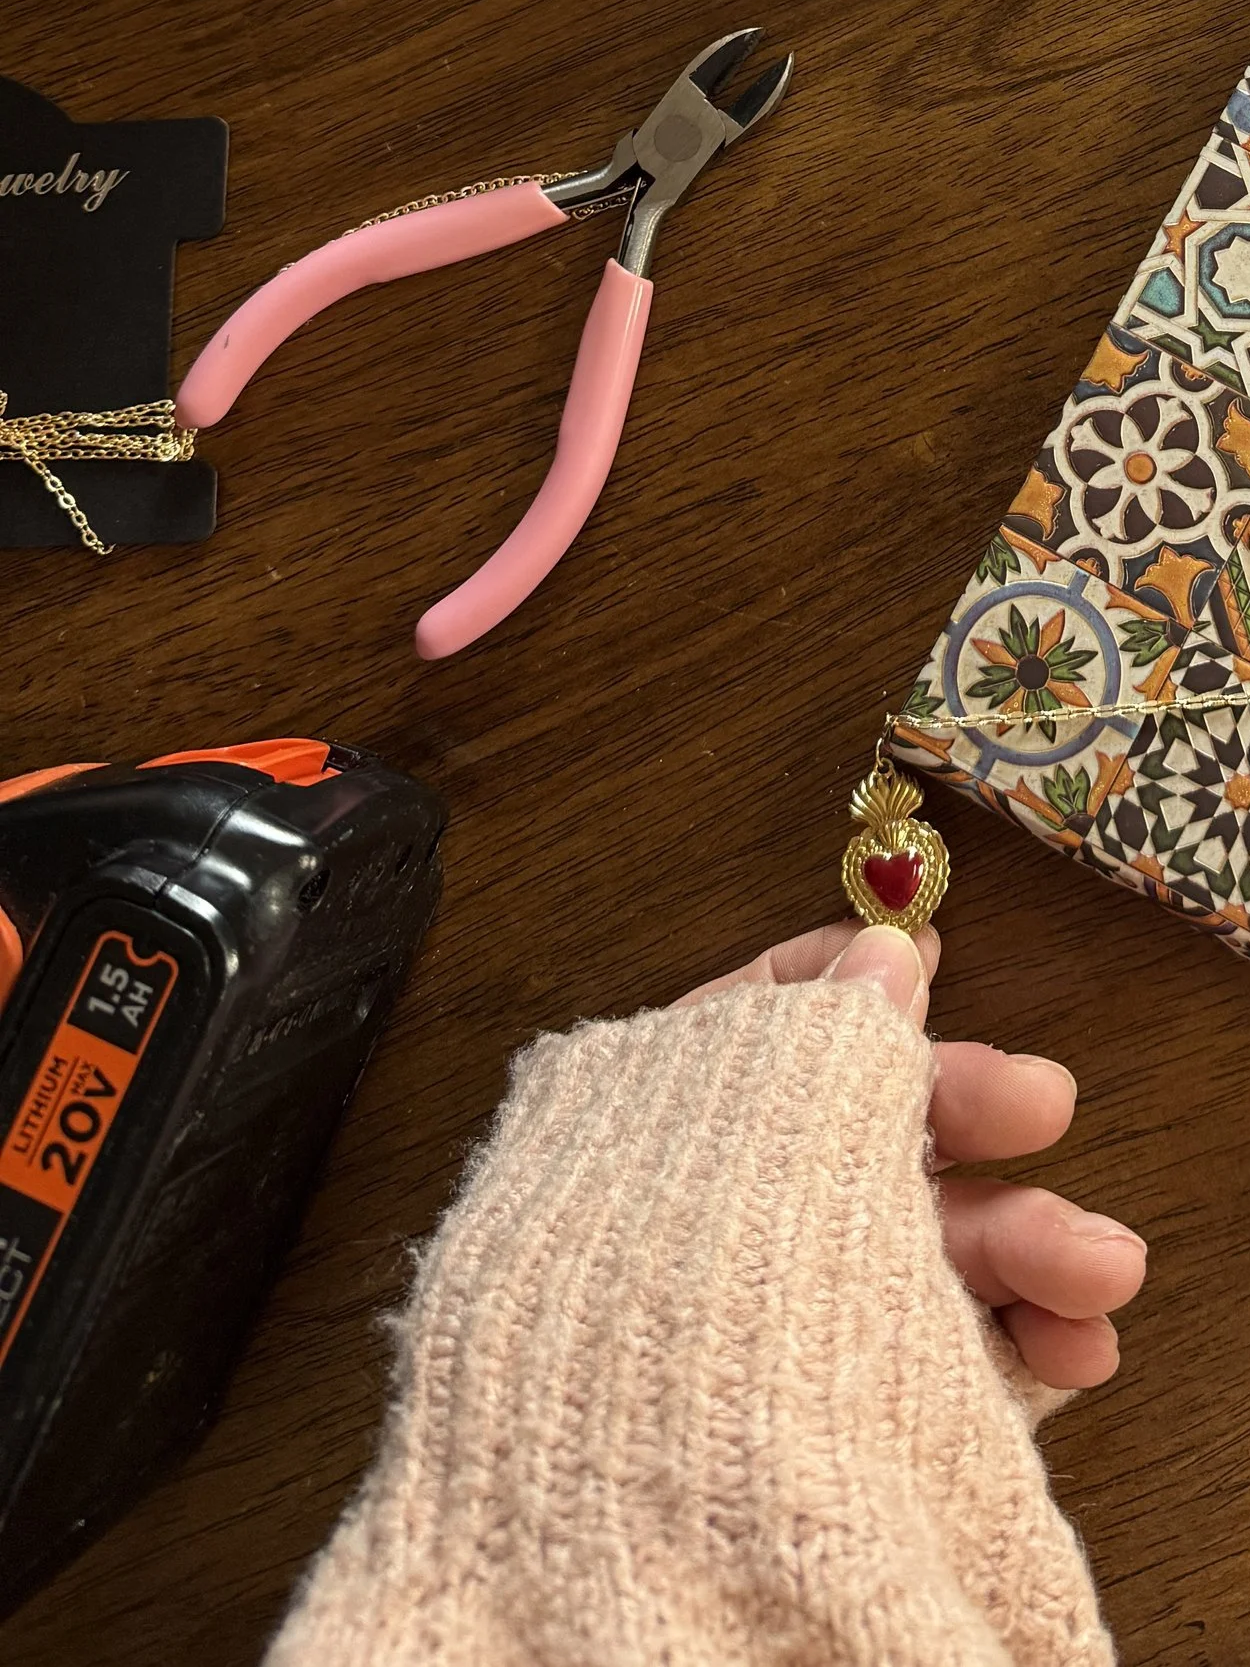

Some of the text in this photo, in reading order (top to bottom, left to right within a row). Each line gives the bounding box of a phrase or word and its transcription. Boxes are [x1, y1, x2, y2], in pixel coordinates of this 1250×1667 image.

[87, 963, 130, 1017] 1.5
[120, 981, 154, 1027] AH
[13, 1056, 68, 1155] LITHIUM
[41, 1067, 117, 1186] 20V
